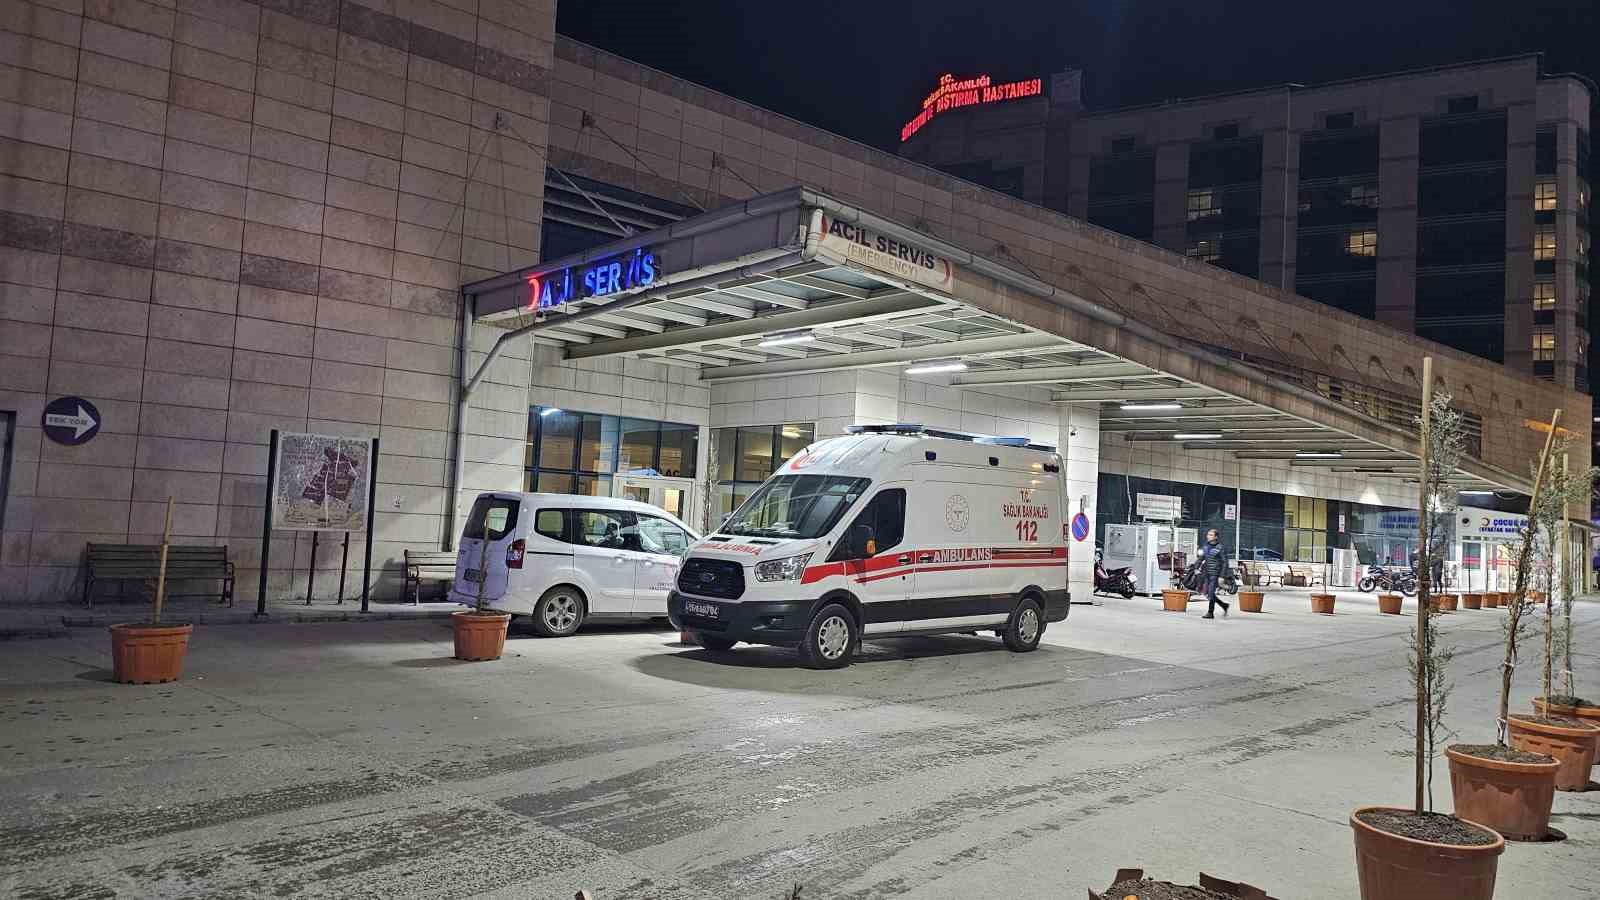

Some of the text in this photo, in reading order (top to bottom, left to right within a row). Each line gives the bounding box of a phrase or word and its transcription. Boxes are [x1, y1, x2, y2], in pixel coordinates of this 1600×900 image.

[1003, 502, 1021, 518] SAĞLIK
[1016, 520, 1038, 541] 112
[933, 548, 991, 562] AMBULANS
